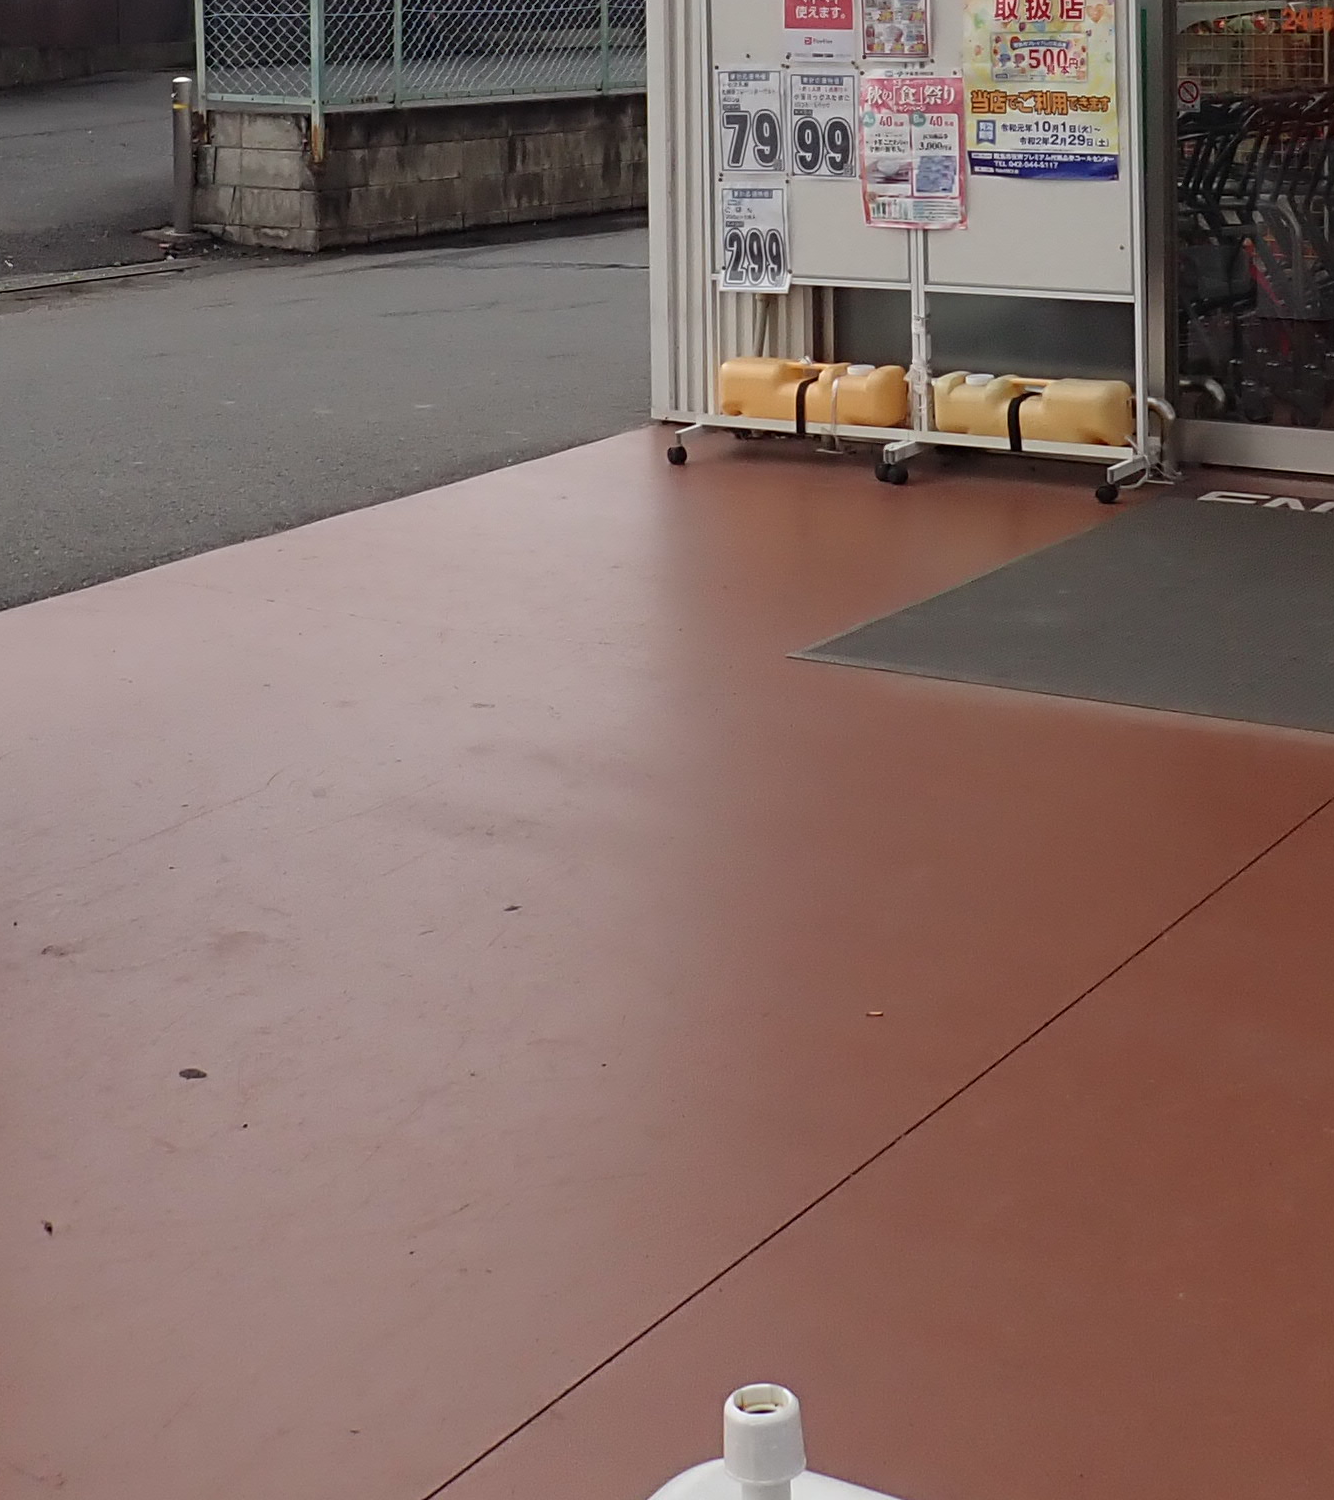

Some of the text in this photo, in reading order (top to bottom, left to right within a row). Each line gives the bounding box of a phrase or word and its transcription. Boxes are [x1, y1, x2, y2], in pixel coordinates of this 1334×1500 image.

[795, 5, 846, 19] 使えます。
[866, 85, 955, 105] 秋の「食」祭り
[970, 89, 1111, 115] 当店でご利用できます
[722, 108, 781, 167] 79
[794, 116, 853, 174] 99
[725, 228, 785, 286] 299
